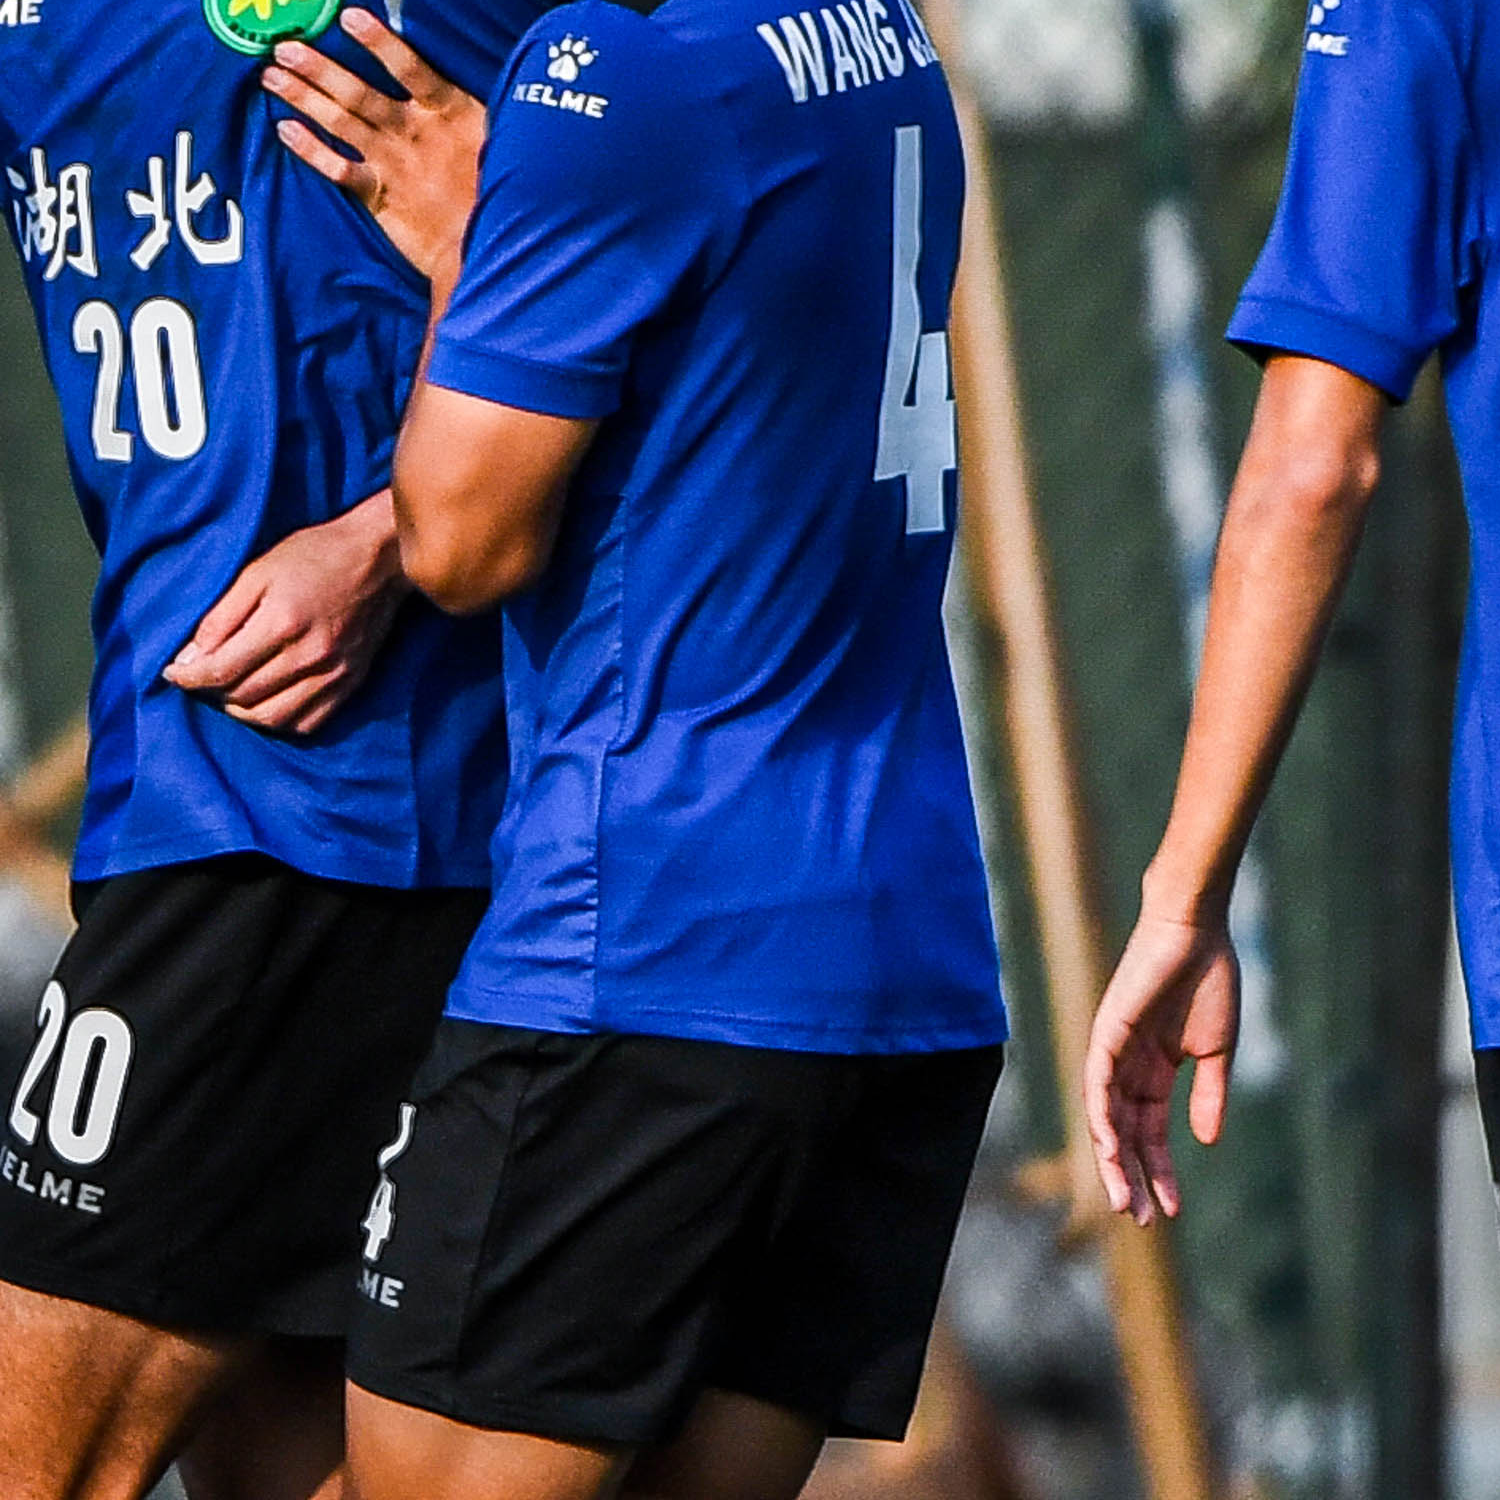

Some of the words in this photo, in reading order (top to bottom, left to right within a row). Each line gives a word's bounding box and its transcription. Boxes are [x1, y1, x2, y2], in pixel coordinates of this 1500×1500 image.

[5, 130, 243, 281] 湖北
[73, 297, 208, 463] 20
[873, 124, 957, 485] 4
[8, 979, 133, 1166] 20
